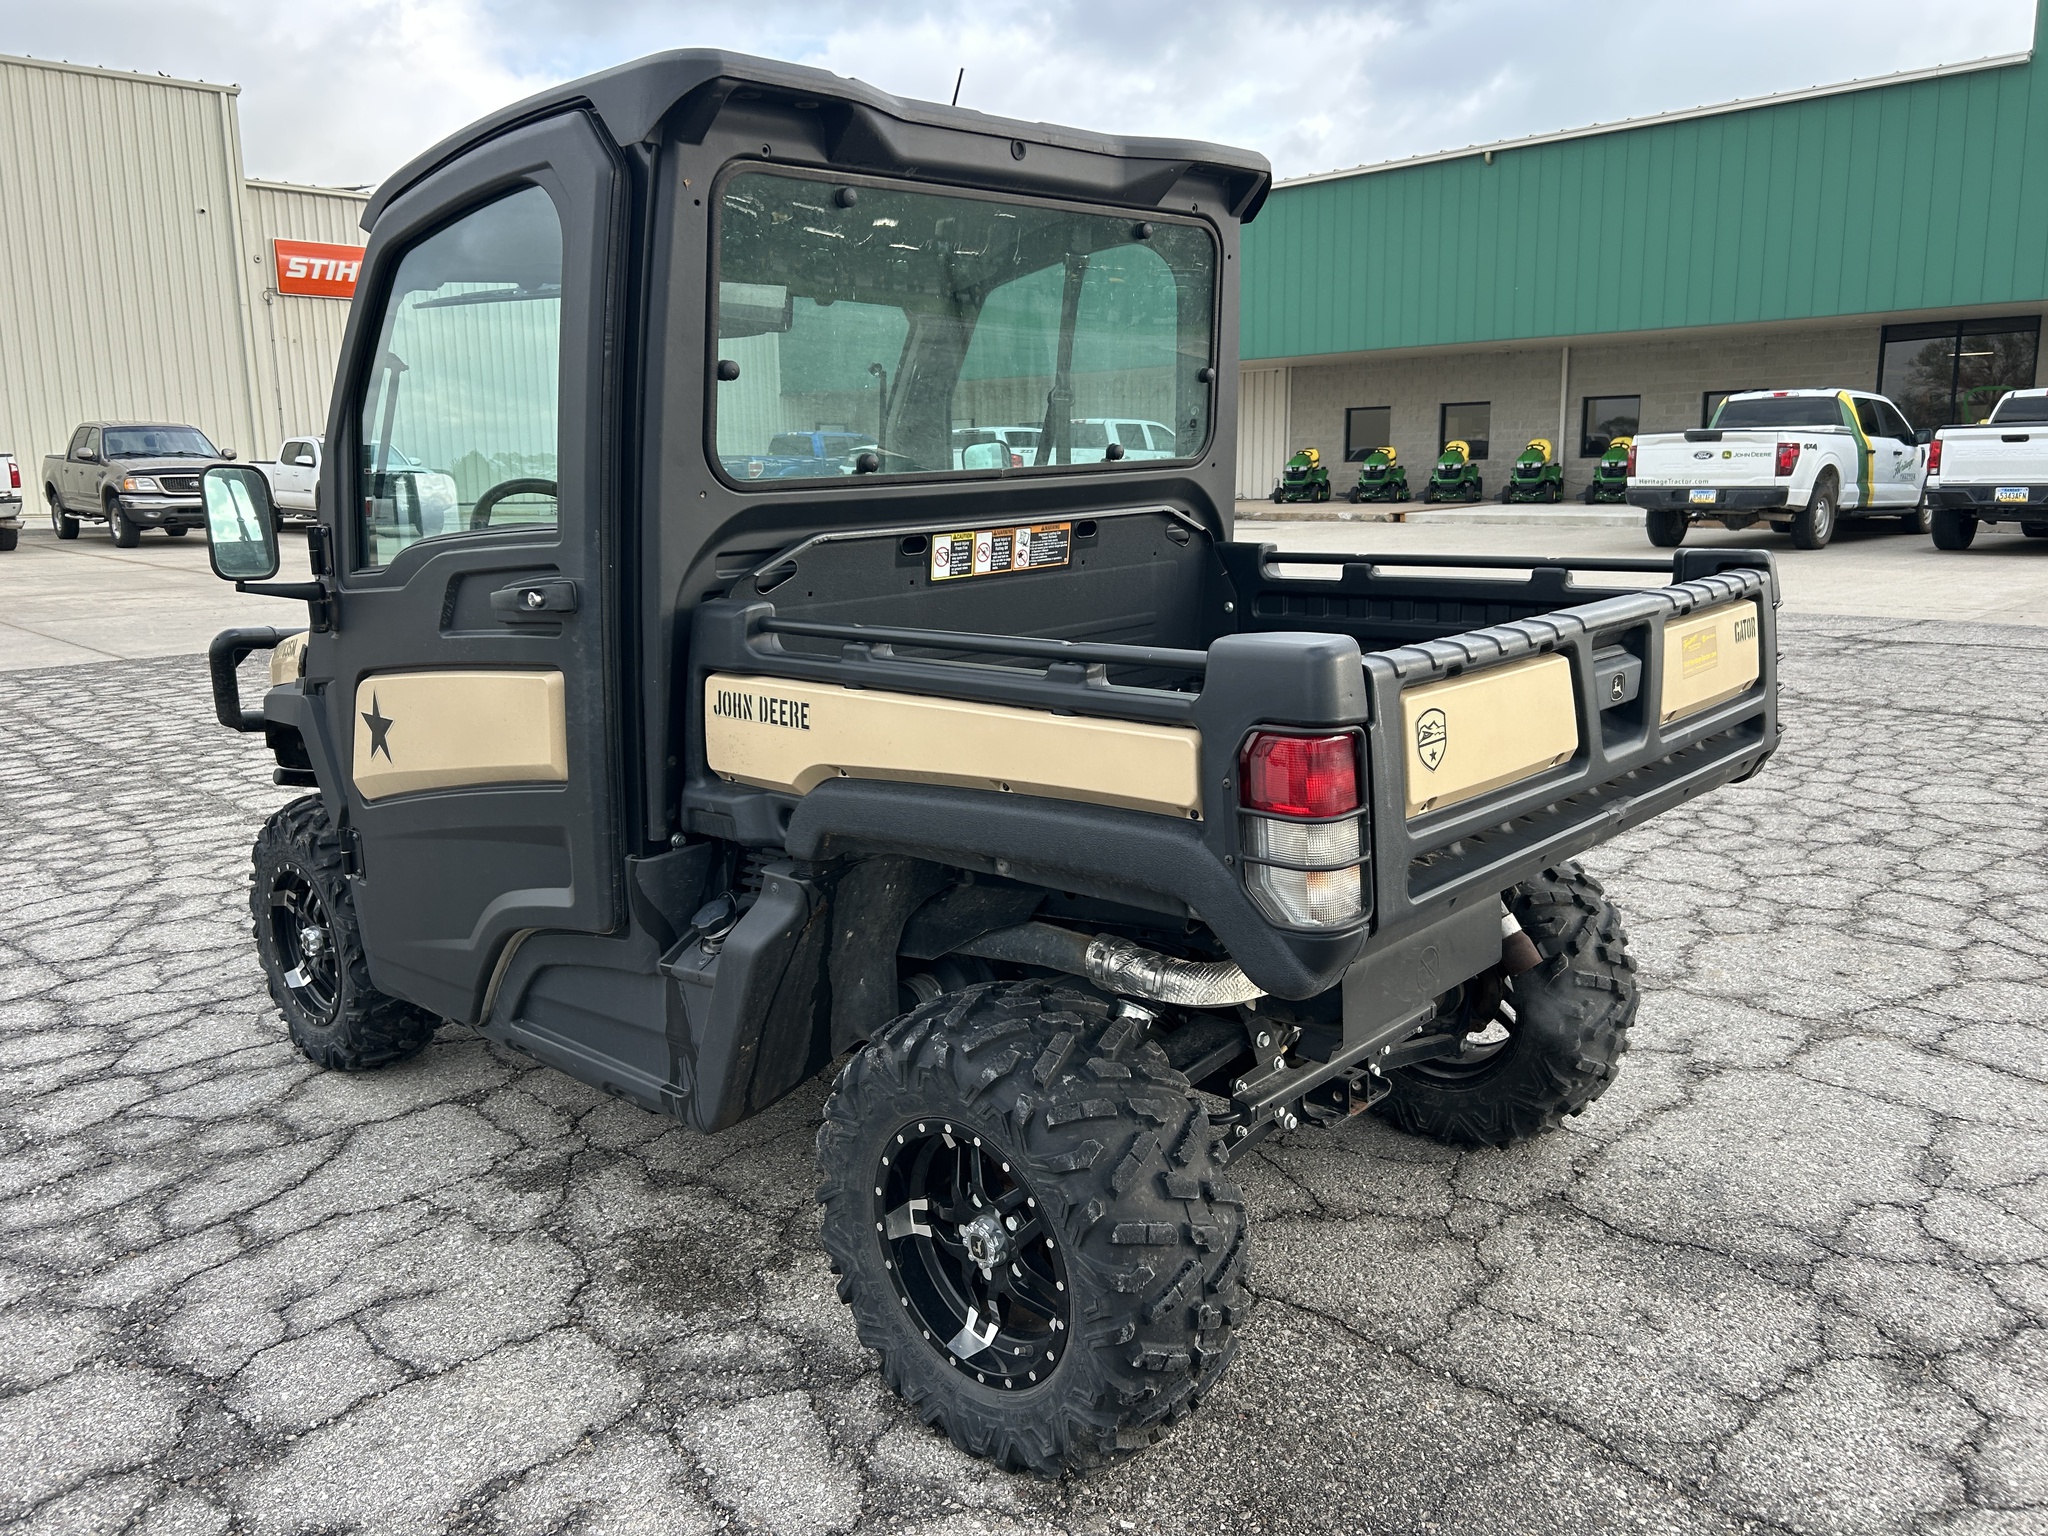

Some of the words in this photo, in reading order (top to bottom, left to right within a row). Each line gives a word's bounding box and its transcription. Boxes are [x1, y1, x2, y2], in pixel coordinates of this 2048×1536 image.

[285, 256, 359, 282] STIH
[1639, 478, 1709, 486] HeritageTractor.com
[1734, 617, 1756, 644] GATOR
[713, 690, 752, 720] JOHN
[759, 696, 810, 730] DEERE
